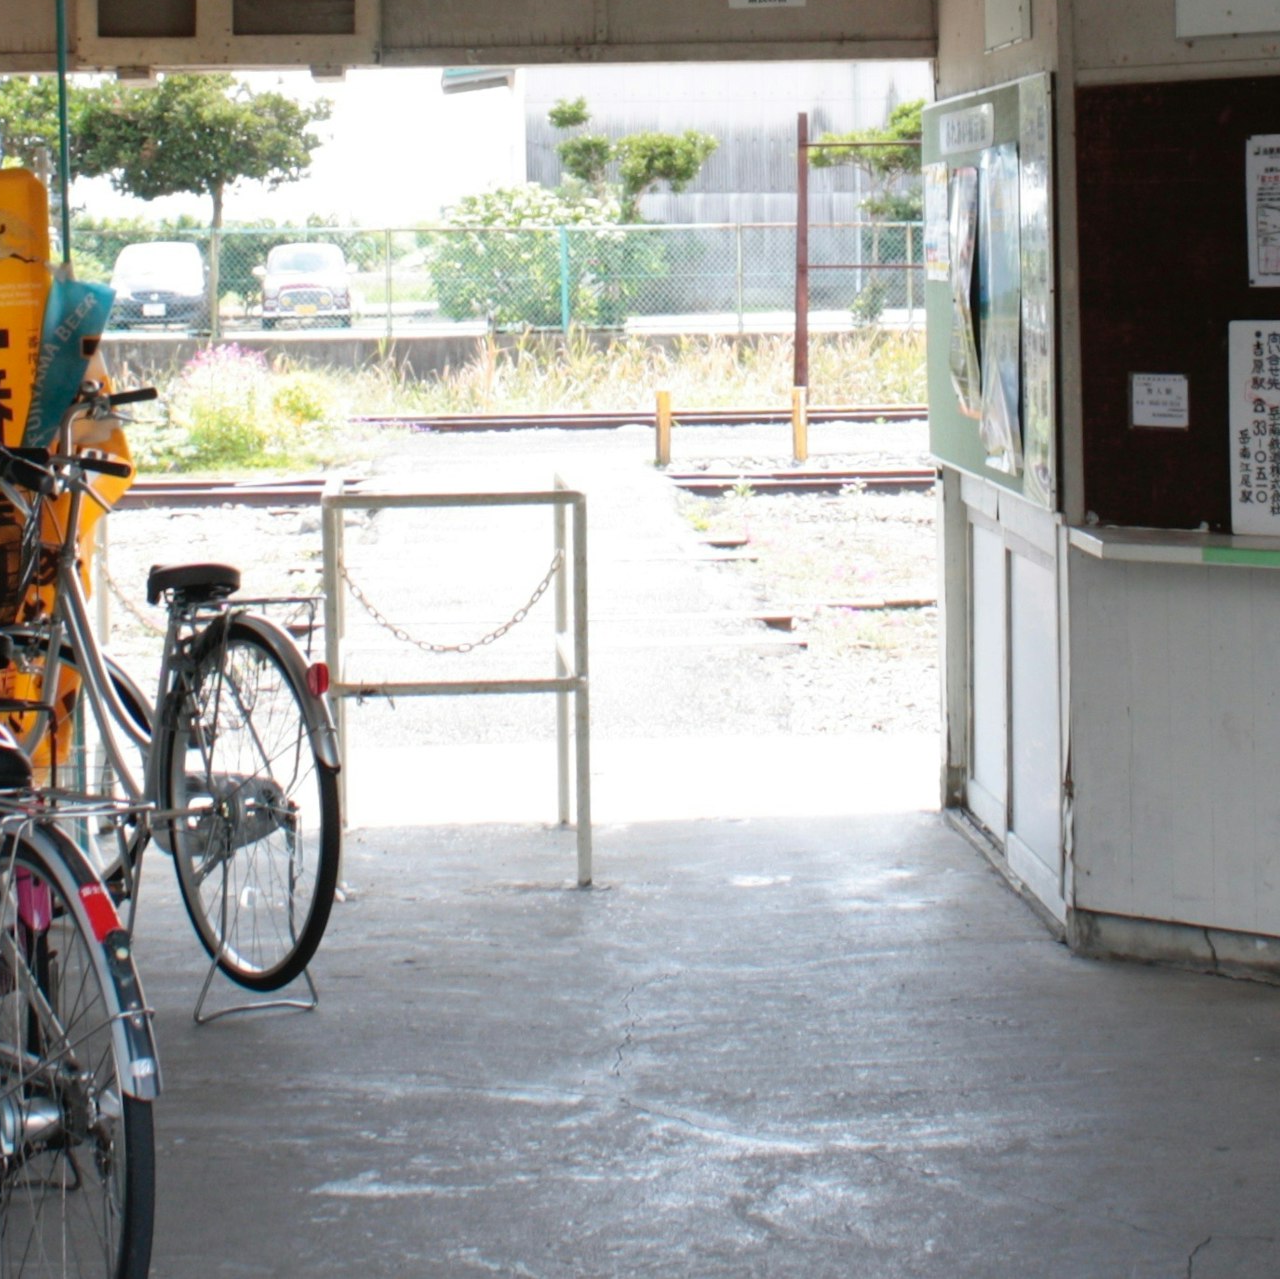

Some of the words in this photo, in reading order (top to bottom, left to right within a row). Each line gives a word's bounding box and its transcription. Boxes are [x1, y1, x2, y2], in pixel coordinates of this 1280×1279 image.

[54, 292, 98, 342] BEER
[1238, 428, 1255, 505] 岳南江尾駅
